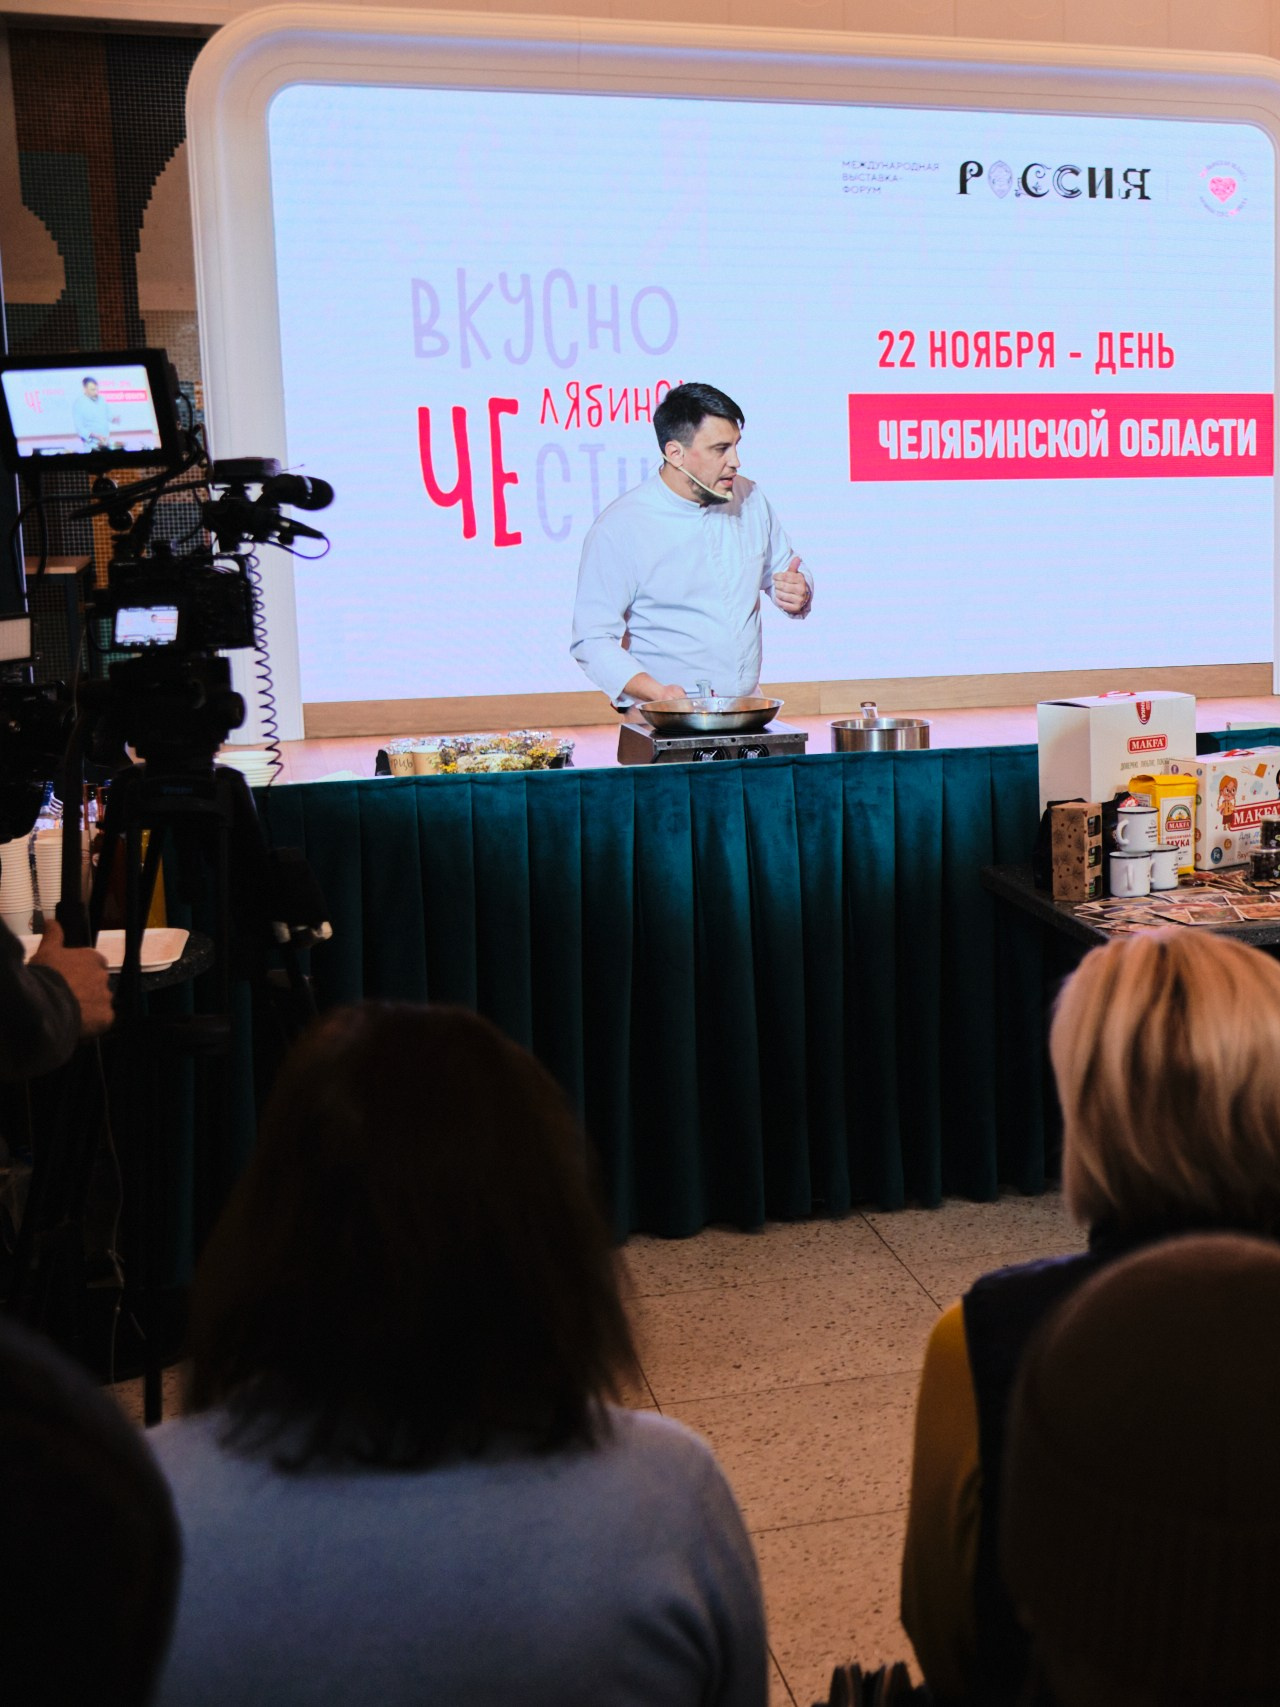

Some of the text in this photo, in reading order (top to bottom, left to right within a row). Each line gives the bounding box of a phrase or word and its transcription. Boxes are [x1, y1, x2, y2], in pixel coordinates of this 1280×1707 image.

[841, 160, 940, 172] МЕЖДУНАРОДНАЯ
[956, 160, 1151, 200] РОССИЯ
[841, 185, 881, 195] ФОРУМ
[410, 267, 680, 369] ВКУСНО
[877, 330, 916, 369] 22
[929, 330, 1056, 369] НОЯБРЯ
[1094, 331, 1176, 376] ДЕНЬ
[878, 408, 1258, 460] ЧЕЛЯБИНСКОЙ ОБЛАСТИ
[1131, 738, 1165, 750] MAKFA
[1233, 805, 1279, 826] MAKFA
